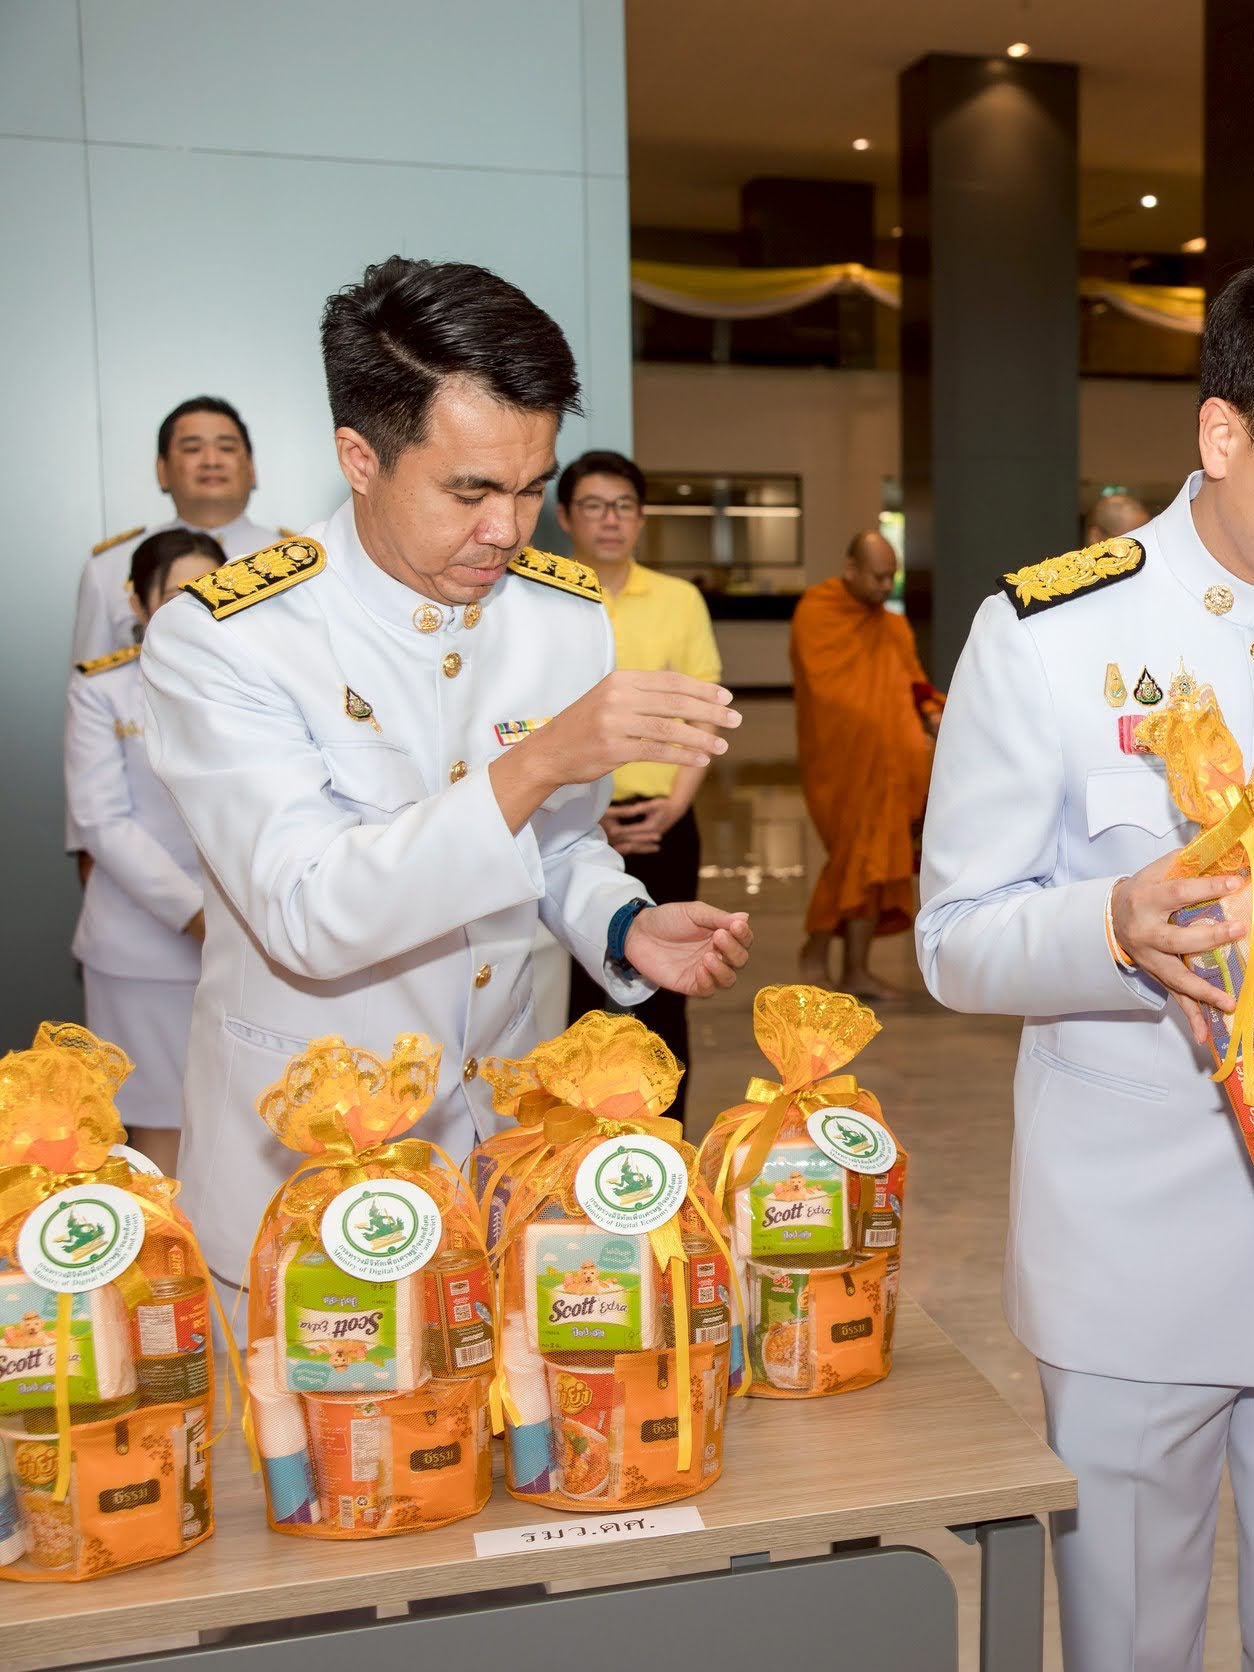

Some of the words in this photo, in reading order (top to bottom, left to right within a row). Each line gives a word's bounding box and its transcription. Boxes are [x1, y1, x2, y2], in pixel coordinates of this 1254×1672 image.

[615, 1221, 639, 1229] Digital
[640, 1209, 669, 1226] Economy
[762, 1202, 805, 1228] Scott
[807, 1206, 832, 1218] Extra
[369, 1266, 394, 1276] Digital
[396, 1252, 425, 1271] Economy
[549, 1296, 597, 1322] Scott
[600, 1300, 628, 1314] Extra
[332, 1311, 383, 1338] Scott
[0, 1348, 43, 1378] Scott
[521, 1518, 655, 1543] รมว.ดศ.
